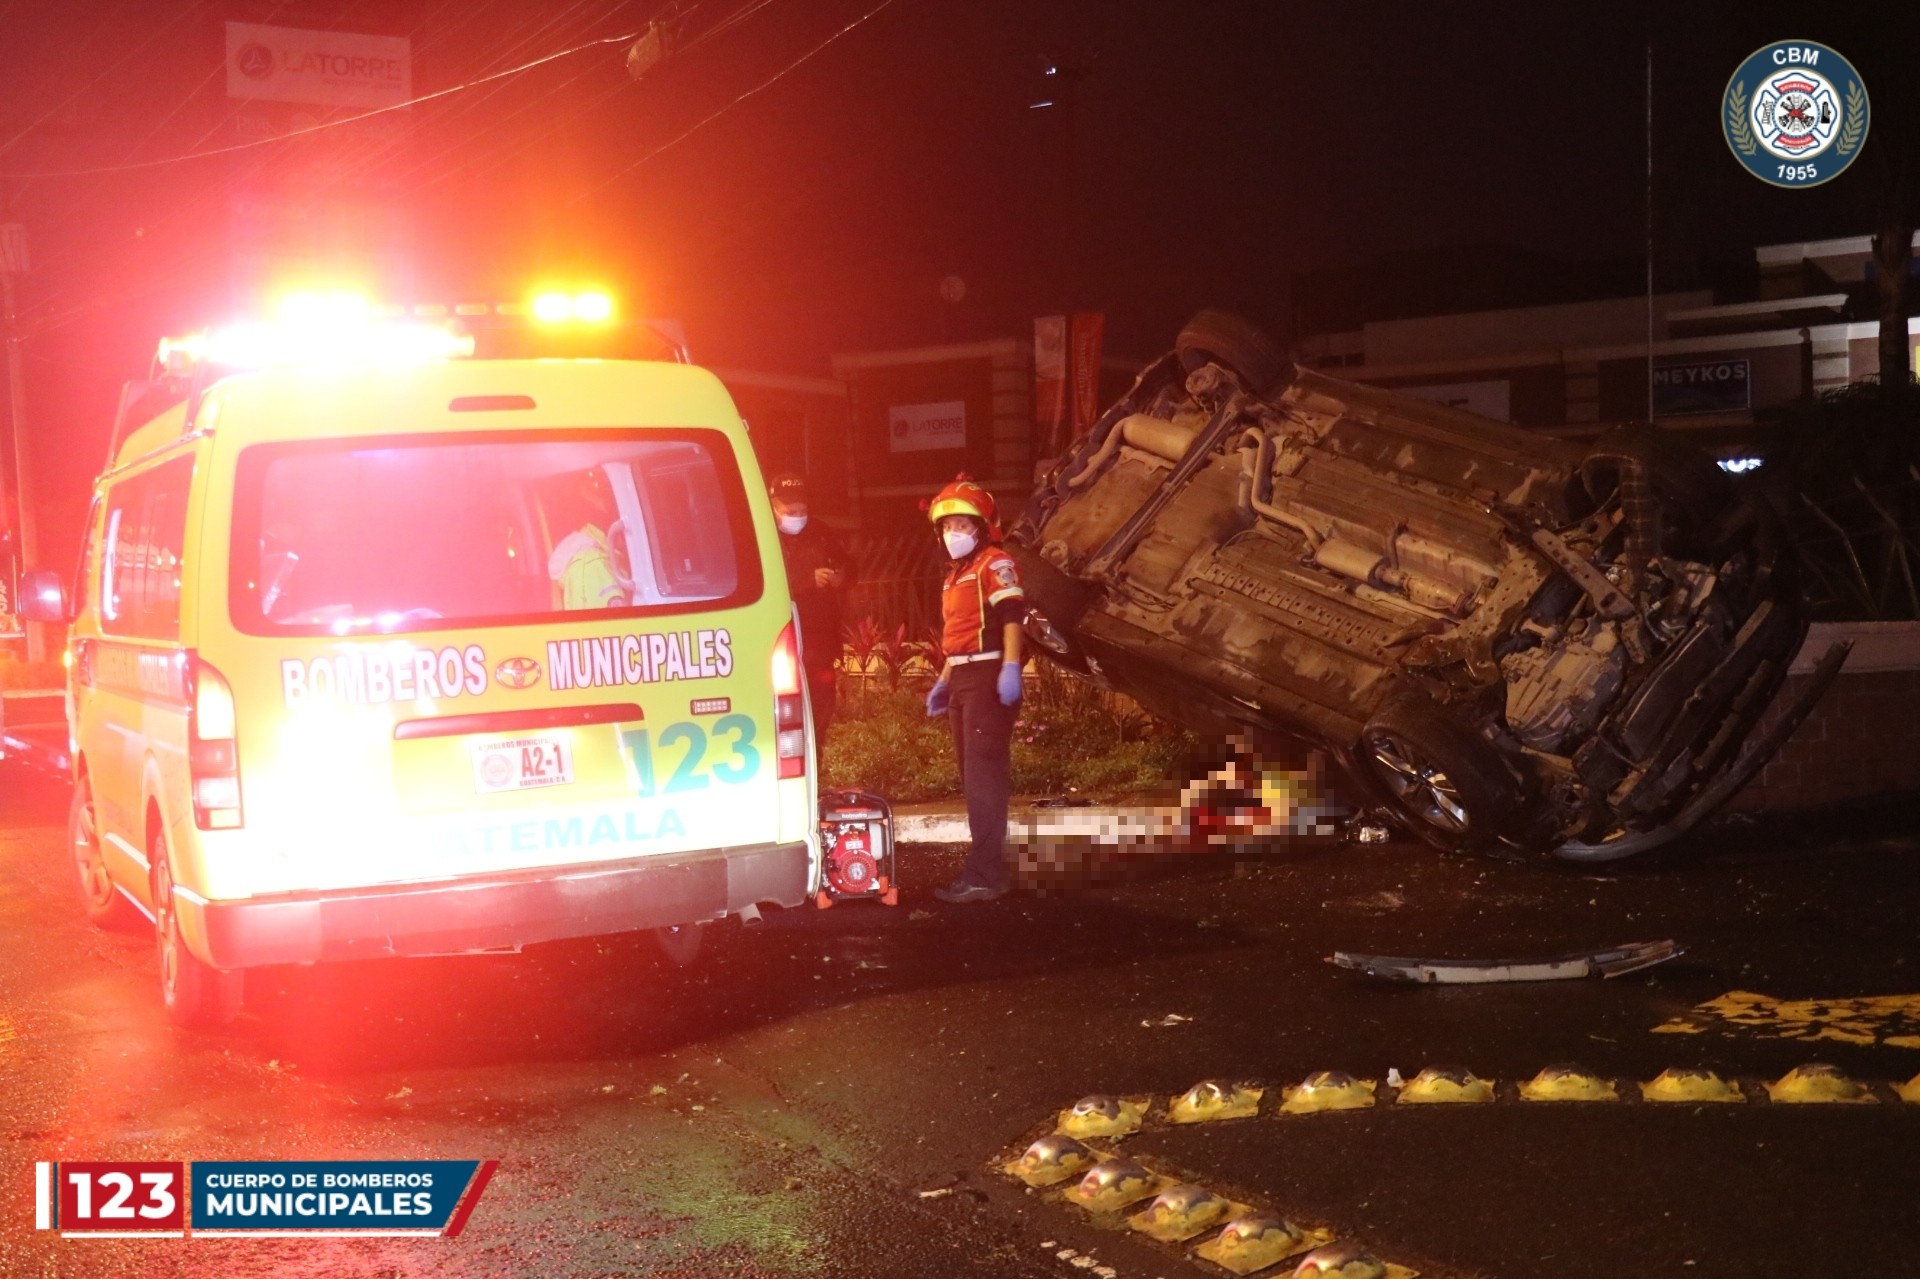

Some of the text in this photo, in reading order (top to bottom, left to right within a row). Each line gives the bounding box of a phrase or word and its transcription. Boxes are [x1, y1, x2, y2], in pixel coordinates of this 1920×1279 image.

[1654, 364, 1746, 385] MEYKOS
[281, 629, 733, 707] BOMBEROS MUNICIPALES
[522, 744, 563, 778] A2-1
[621, 713, 761, 797] 123
[439, 807, 687, 858] ATEMALA
